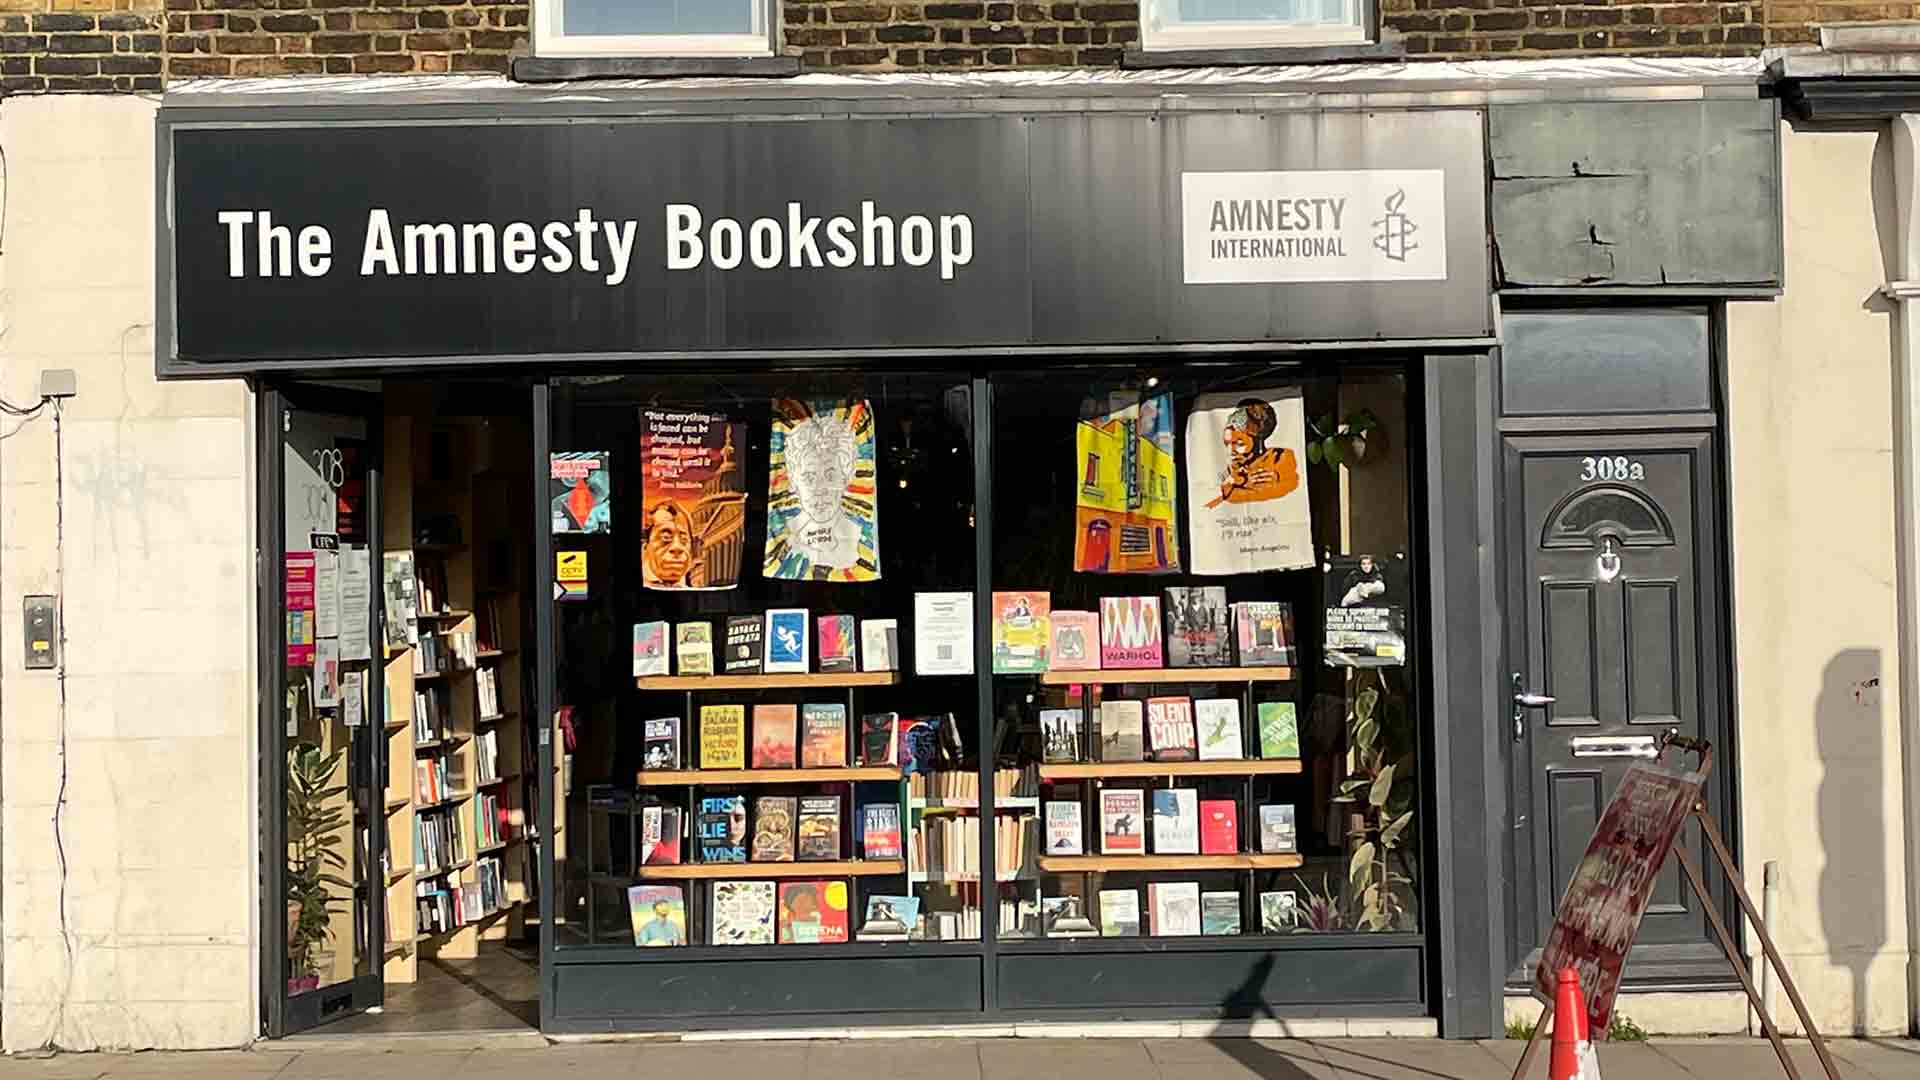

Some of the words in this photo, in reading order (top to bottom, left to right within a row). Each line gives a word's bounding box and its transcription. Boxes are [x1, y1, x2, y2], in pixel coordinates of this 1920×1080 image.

[1210, 199, 1346, 232] AMNESTY
[218, 211, 332, 278] The
[360, 208, 637, 285] Amnesty
[666, 201, 974, 279] Bookshop
[1211, 237, 1347, 259] INTERNATIONAL
[1581, 456, 1645, 481] 308a
[1106, 650, 1160, 661] WARHOL
[1148, 702, 1190, 724] SILENT
[1151, 722, 1196, 750] COUP
[703, 797, 744, 814] FIRST
[703, 822, 727, 838] LIE
[703, 846, 746, 862] WINS
